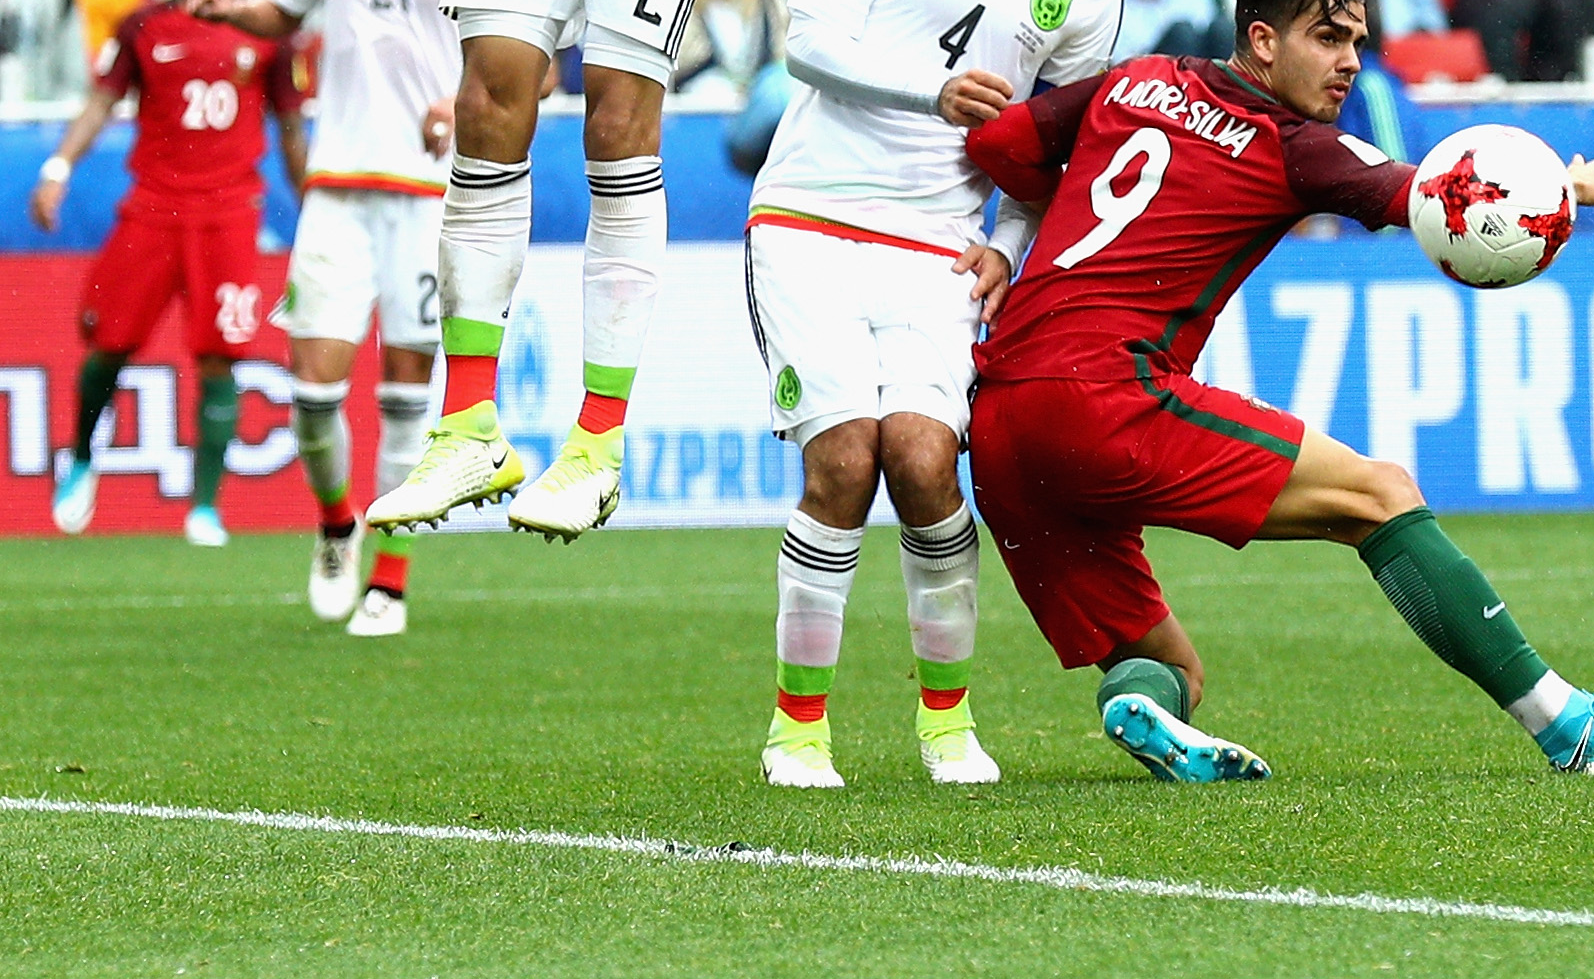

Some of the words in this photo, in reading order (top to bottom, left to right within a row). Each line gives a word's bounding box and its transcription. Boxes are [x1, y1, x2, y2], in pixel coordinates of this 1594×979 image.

[938, 3, 987, 70] 4
[181, 78, 240, 132] 20
[1184, 100, 1259, 159] SILVA
[1052, 126, 1172, 271] 9
